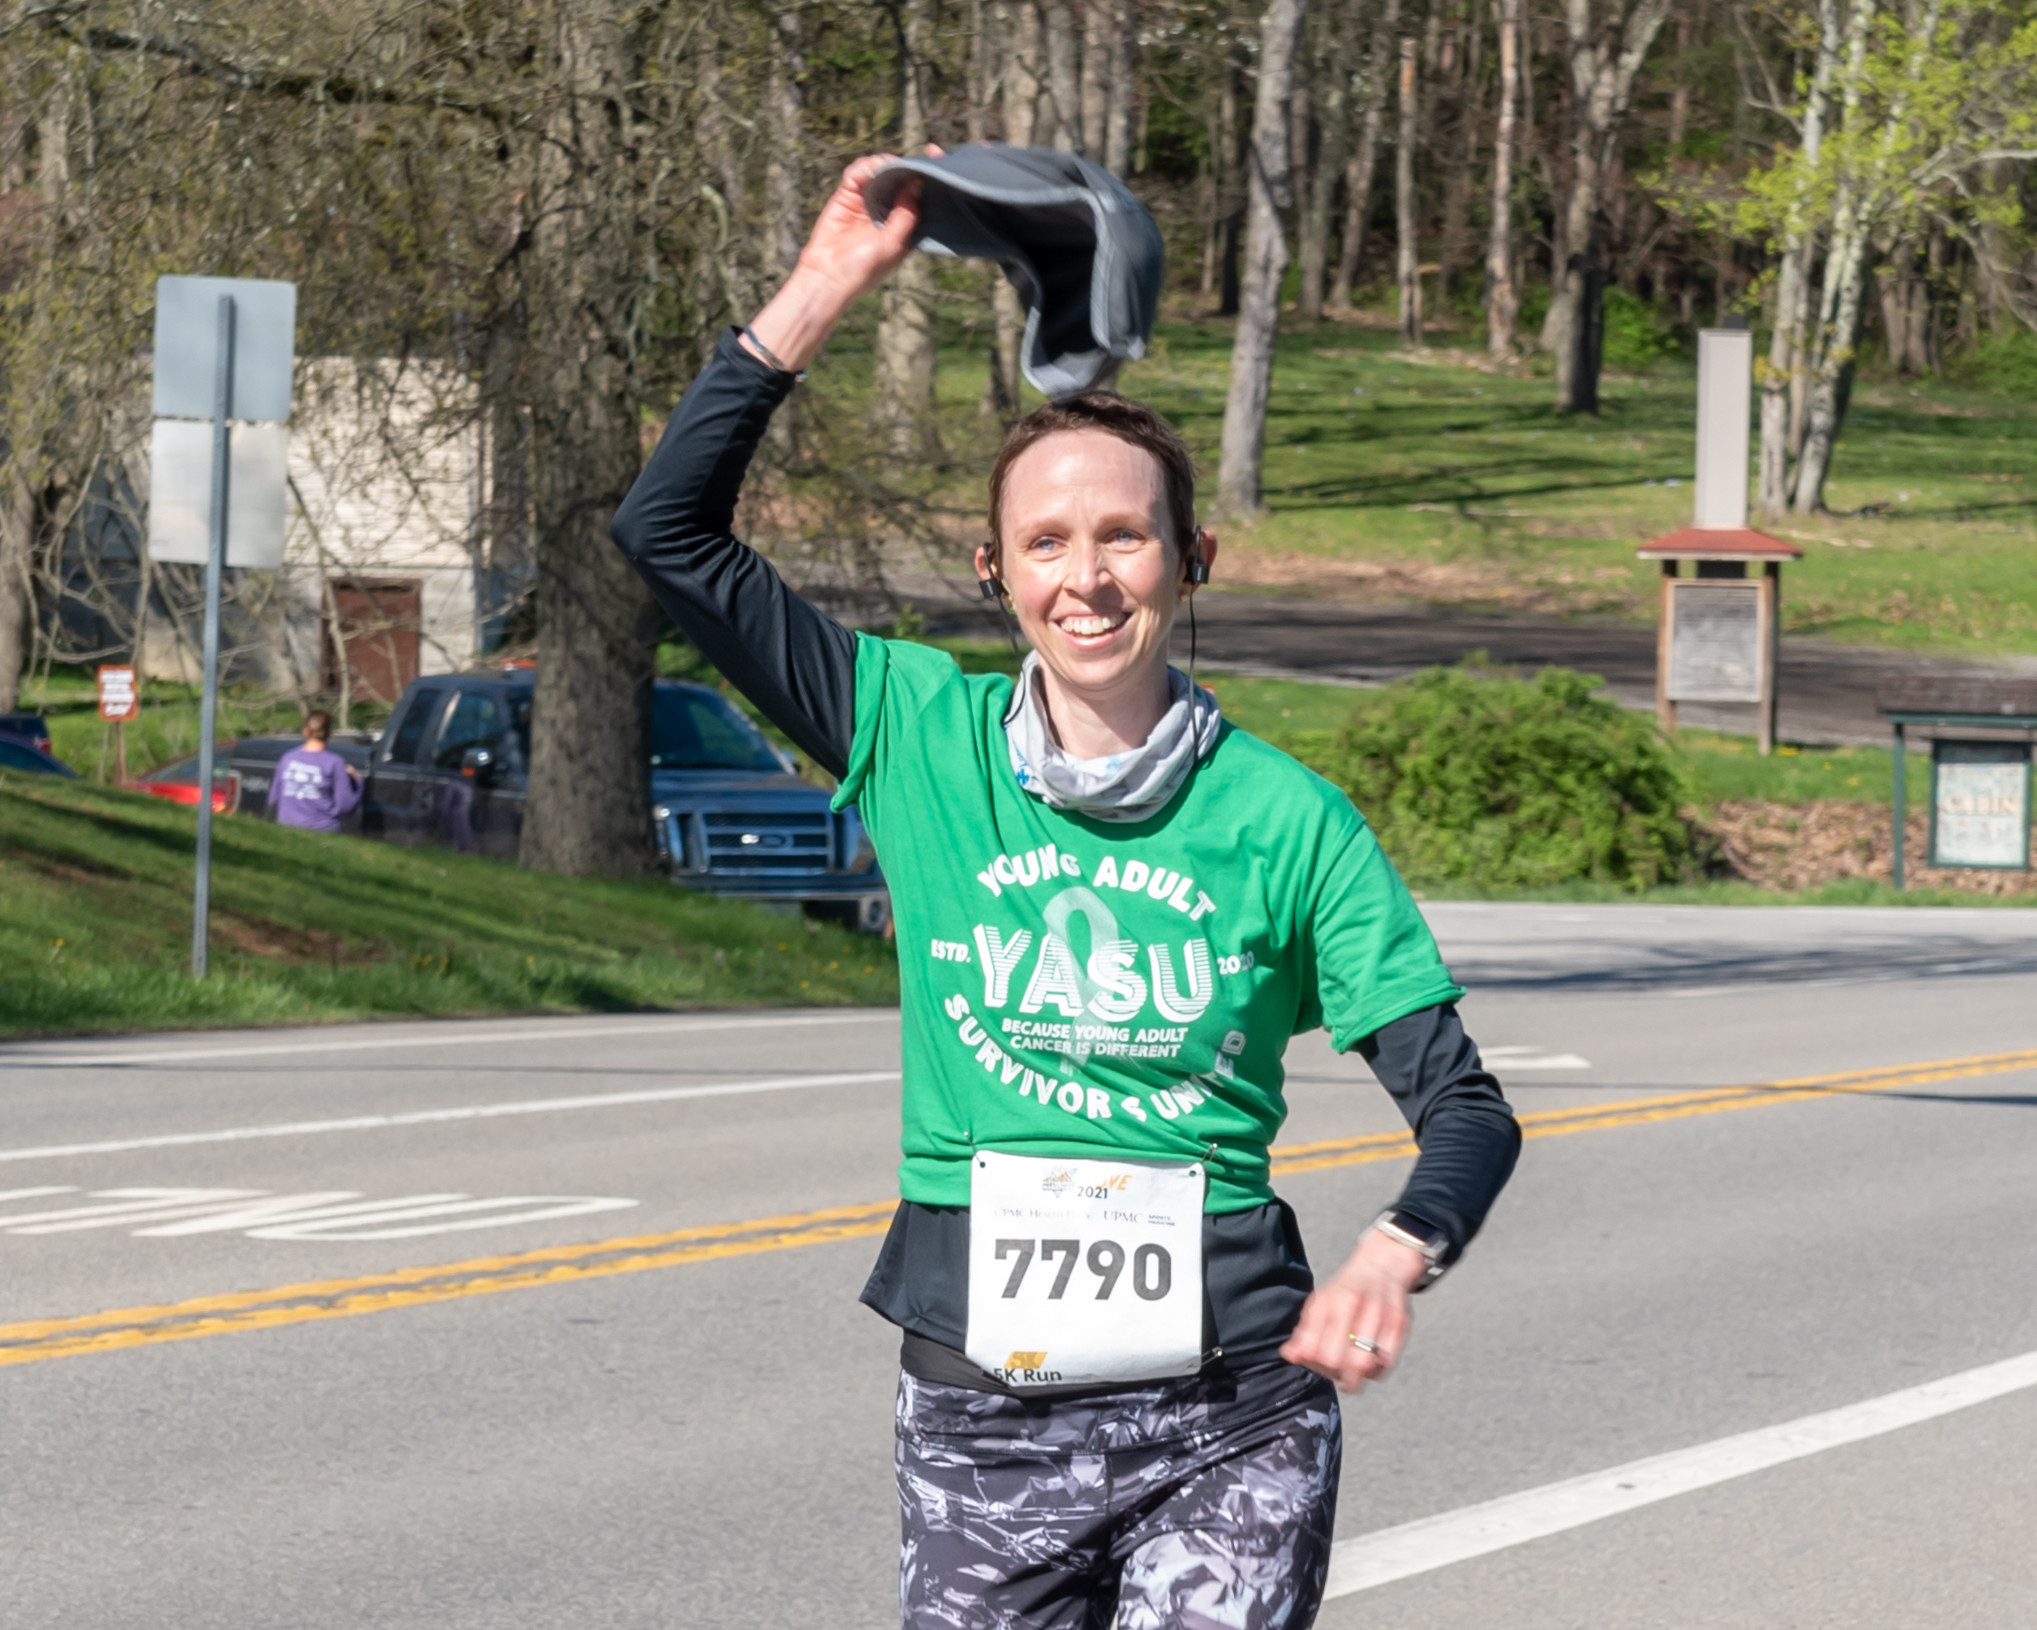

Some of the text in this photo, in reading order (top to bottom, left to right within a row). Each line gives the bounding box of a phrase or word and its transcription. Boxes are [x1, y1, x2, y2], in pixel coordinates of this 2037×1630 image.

[977, 843, 1216, 921] YOUNG ADULT
[973, 923, 1213, 1023] YASU
[1002, 1018, 1188, 1043] BECAUSE YOUNG ADULT
[1010, 1036, 1181, 1058] CANCER IS DIFFERENT
[1077, 1186, 1108, 1200] 2021
[994, 1239, 1172, 1301] 7790
[1023, 1368, 1063, 1382] Run
